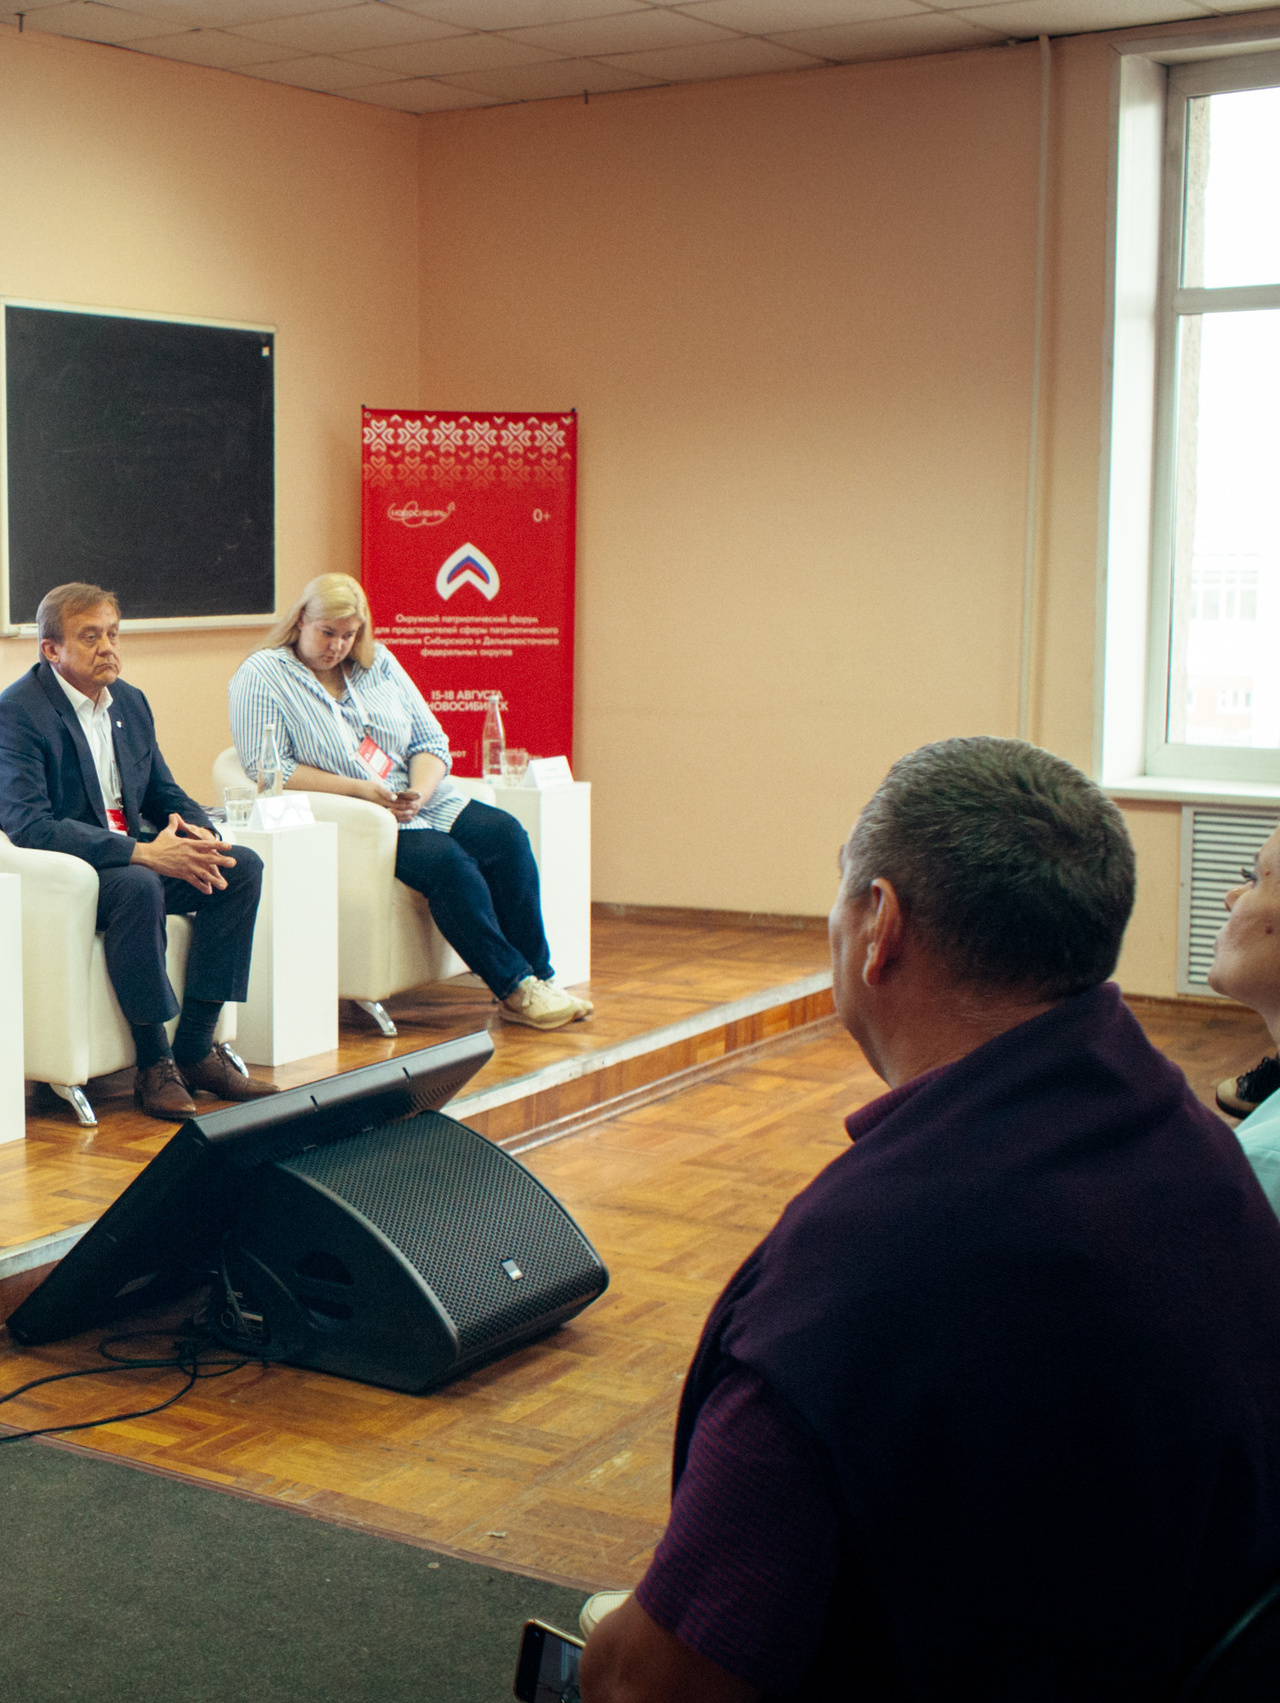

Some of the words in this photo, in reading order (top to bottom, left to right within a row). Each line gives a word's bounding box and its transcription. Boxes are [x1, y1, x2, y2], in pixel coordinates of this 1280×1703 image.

[532, 508, 551, 523] 0+
[441, 615, 508, 625] патриотический
[509, 615, 538, 625] форум
[391, 625, 458, 636] представителей
[489, 627, 560, 636] патриотического
[423, 635, 474, 646] Сибирского
[482, 635, 560, 647] Дальневосточного
[421, 648, 479, 658] федеральных
[479, 649, 513, 658] округов
[431, 689, 455, 701] 15-18
